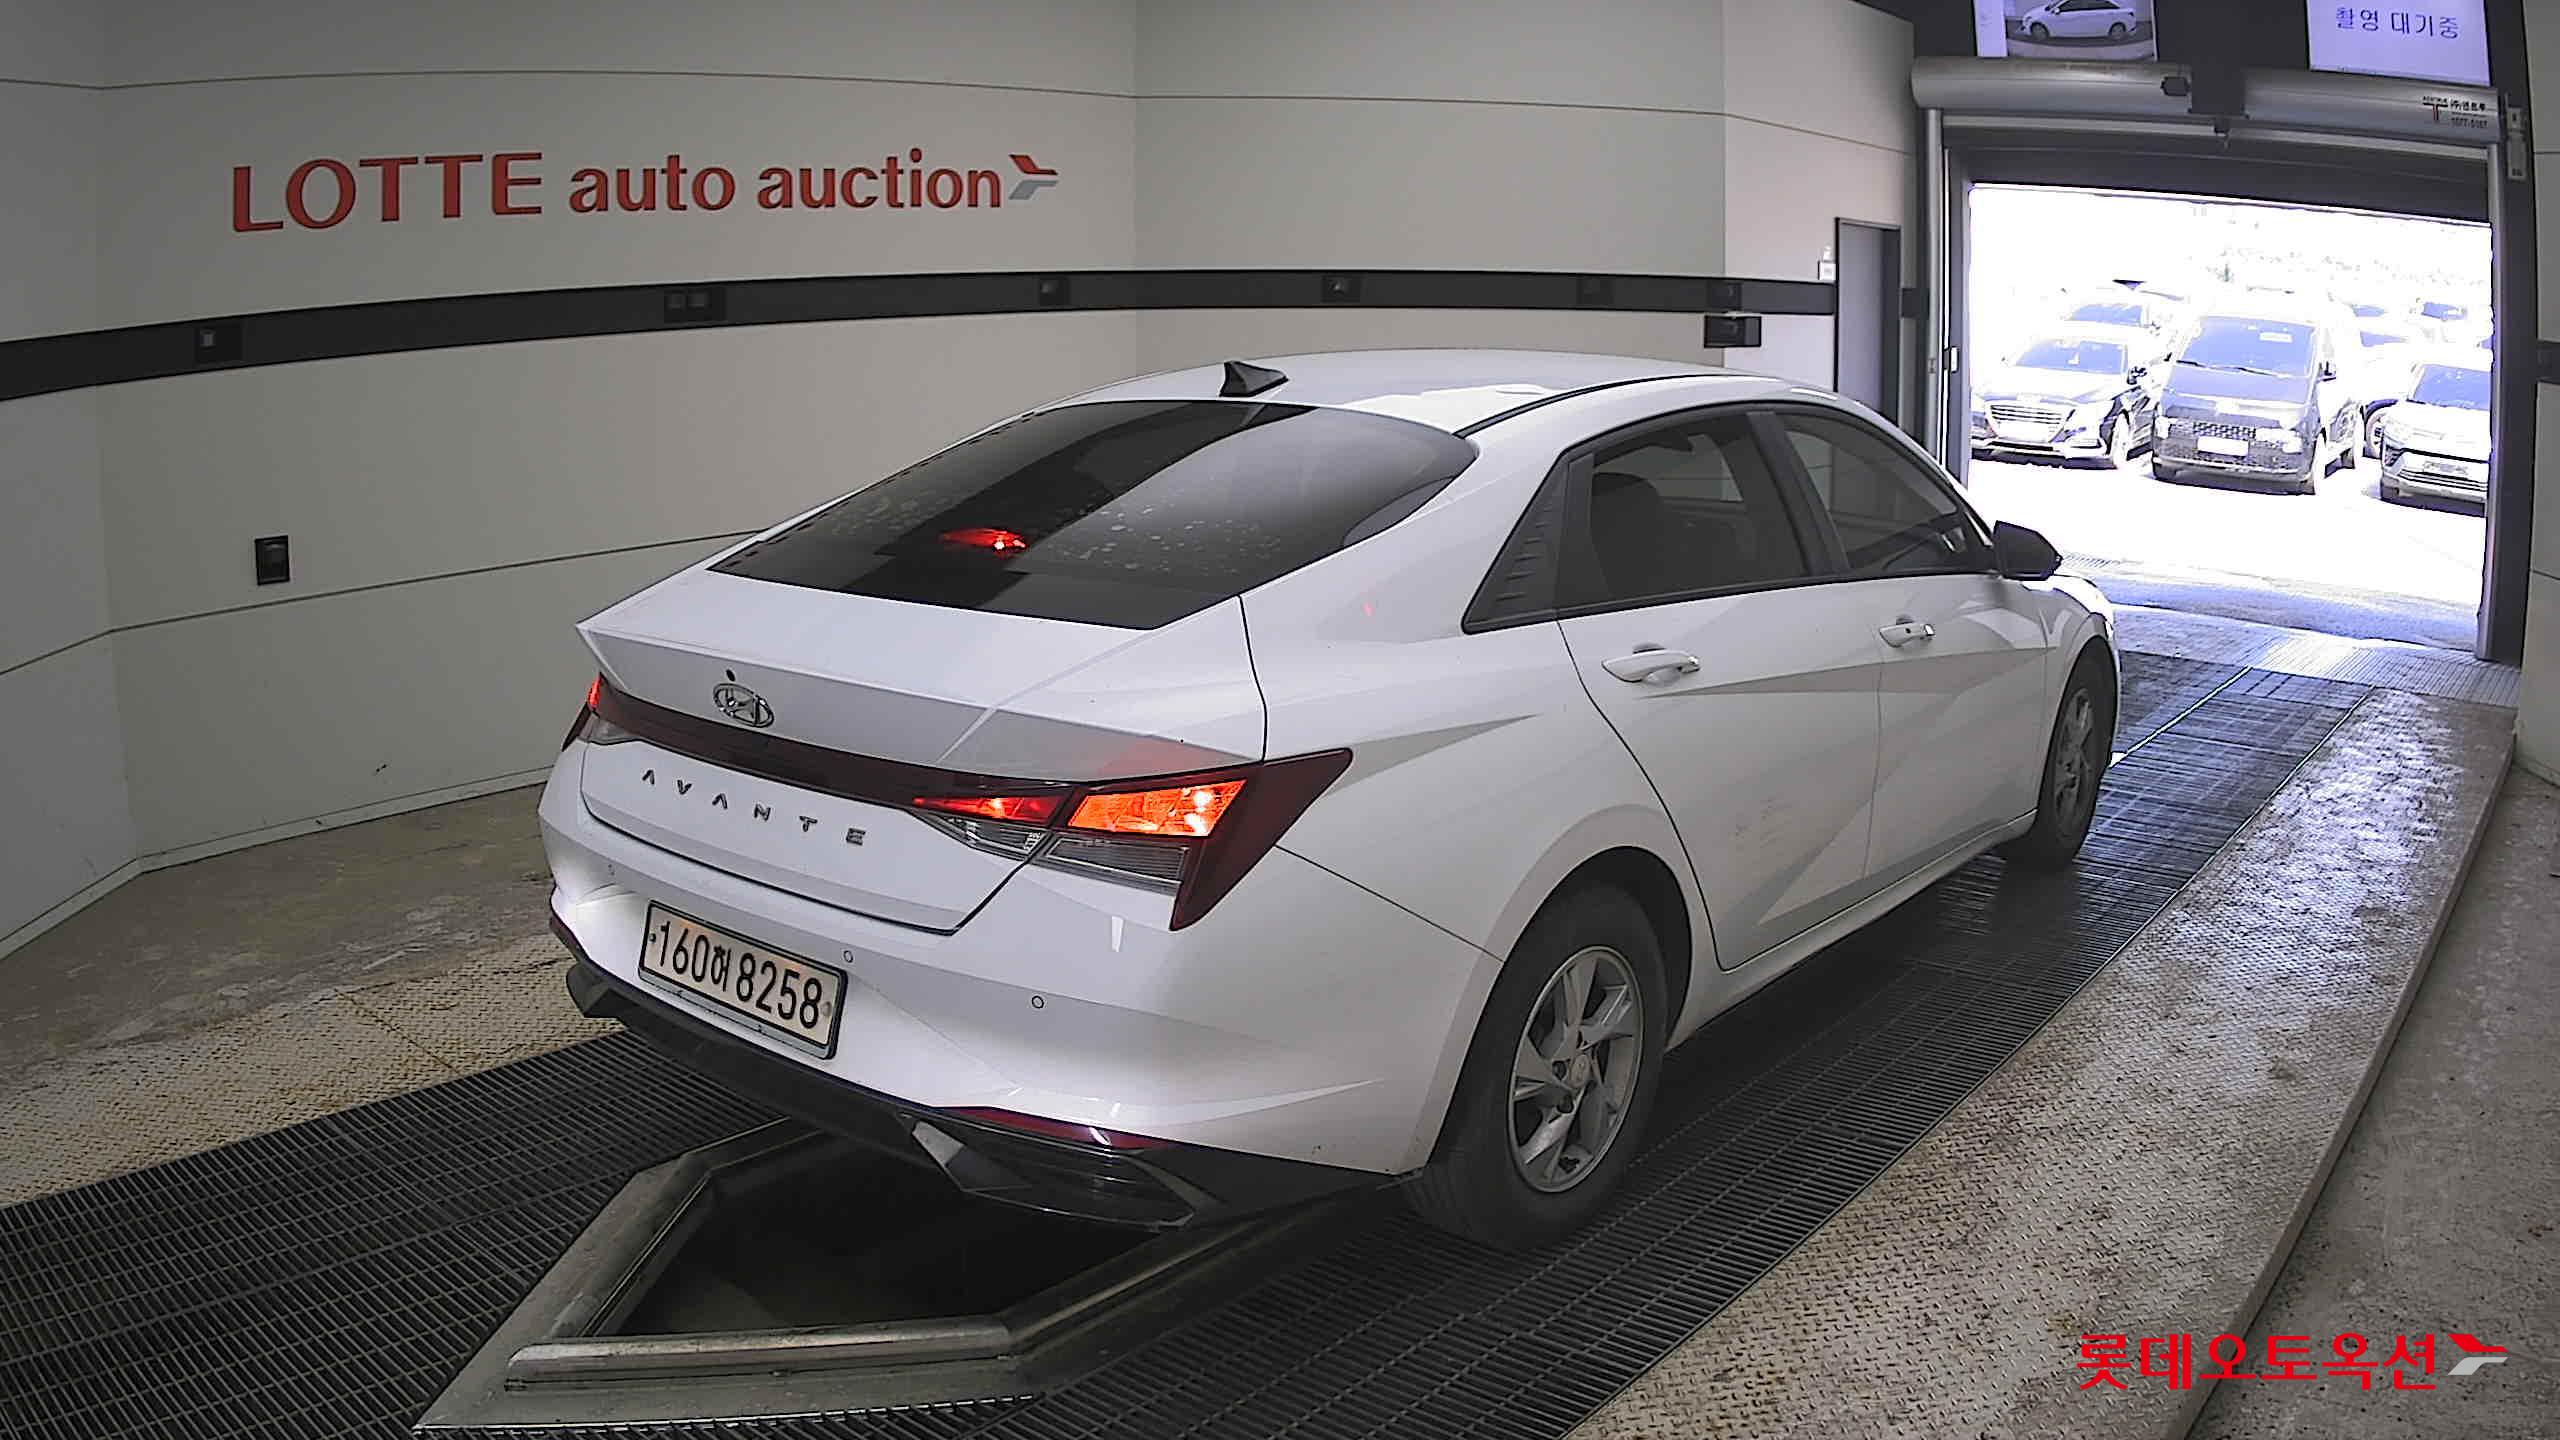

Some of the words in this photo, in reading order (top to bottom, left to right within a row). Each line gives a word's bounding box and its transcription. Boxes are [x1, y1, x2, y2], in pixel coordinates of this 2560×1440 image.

[2336, 7, 2379, 31] 촬영
[2391, 12, 2459, 39] 대기중
[233, 152, 542, 233] LOTTE
[570, 154, 735, 212] auto
[757, 147, 1002, 210] auction
[642, 769, 867, 847] AVANTE
[659, 920, 824, 1029] 160허8258
